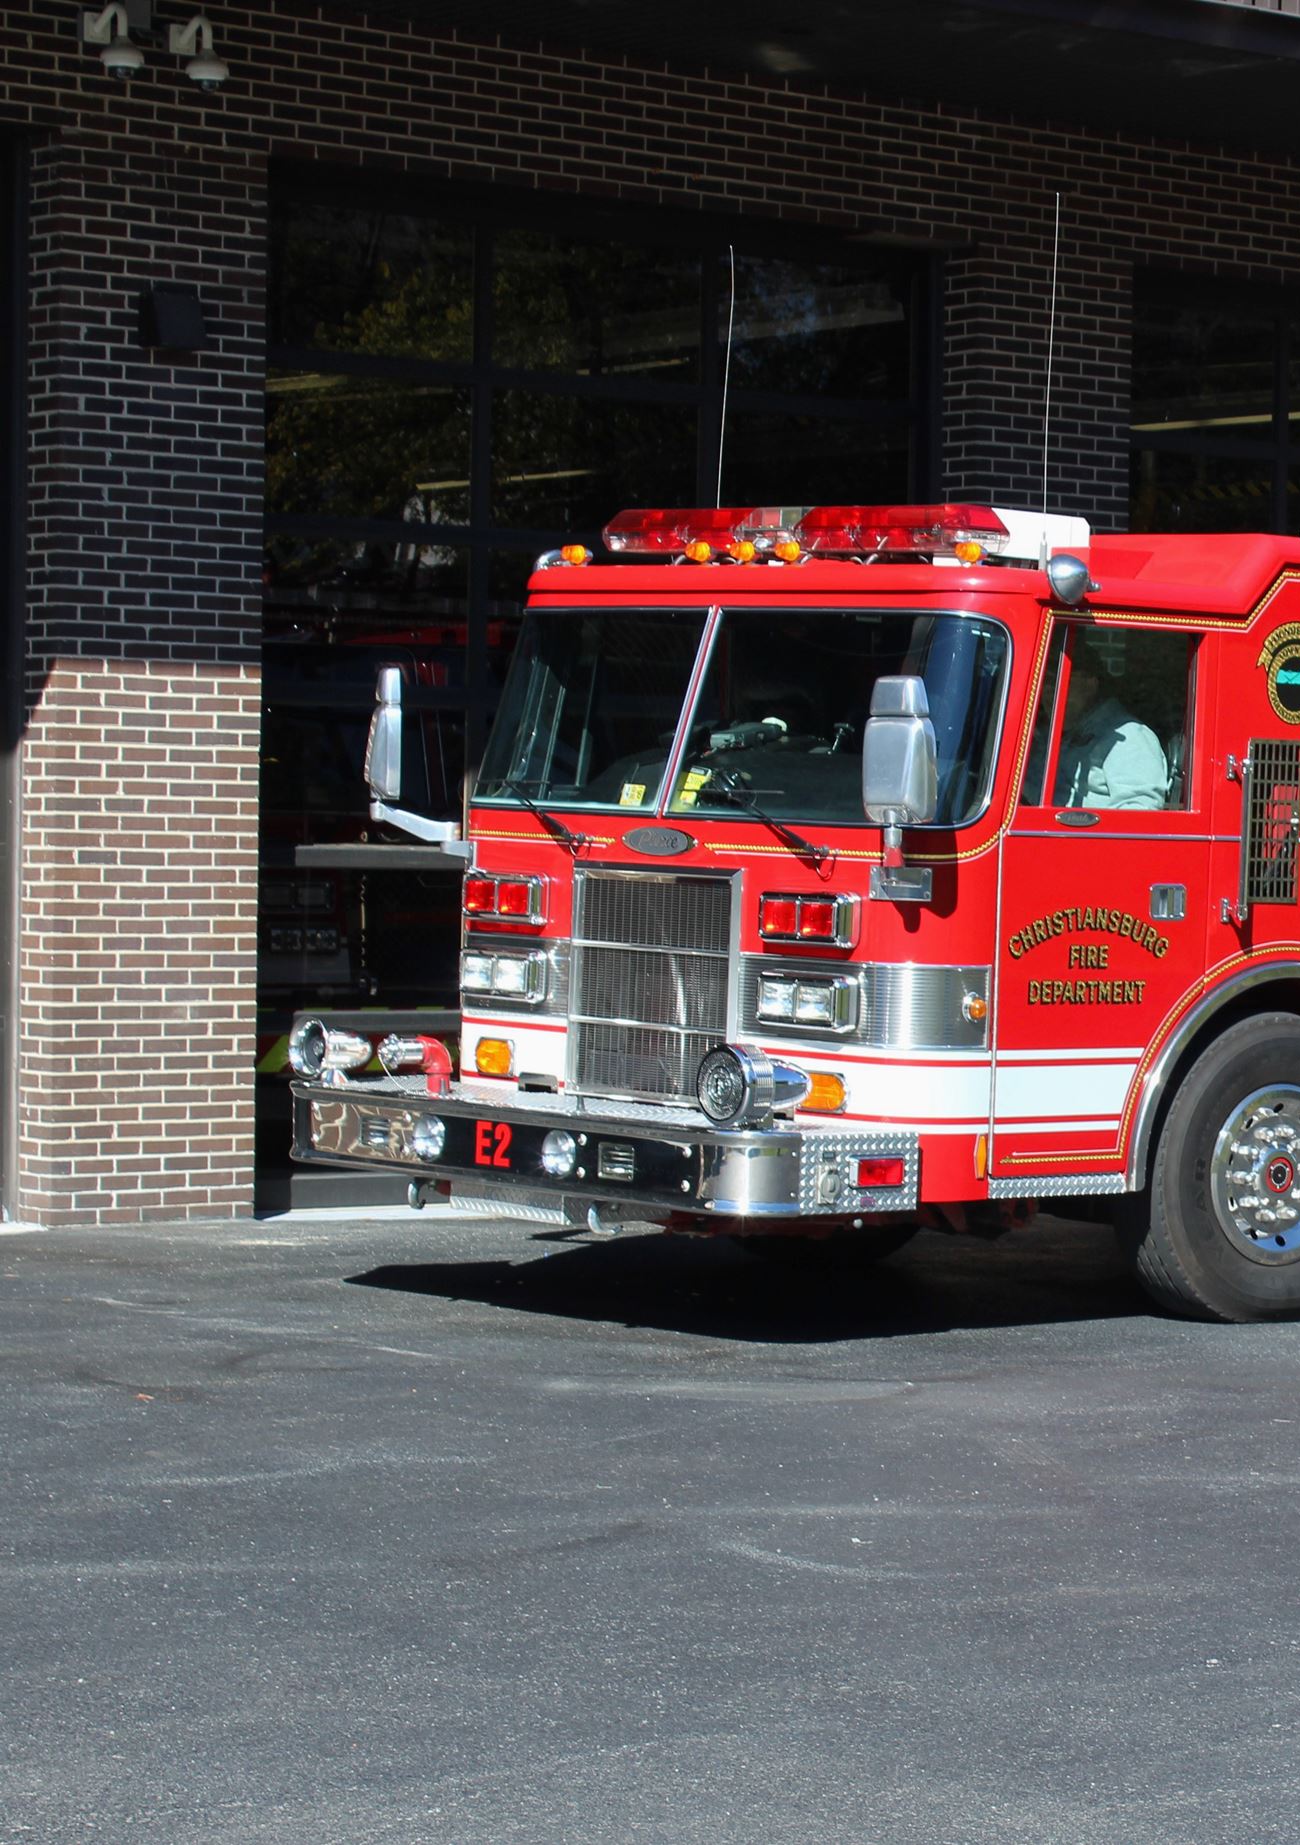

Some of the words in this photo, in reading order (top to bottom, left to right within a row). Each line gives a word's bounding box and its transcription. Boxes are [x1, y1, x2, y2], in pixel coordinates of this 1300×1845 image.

[1008, 905, 1170, 959] CHRISTIANSBURG
[1068, 945, 1109, 969] FIRE
[1028, 980, 1147, 1005] DEPARTMENT
[474, 1120, 512, 1168] E2
